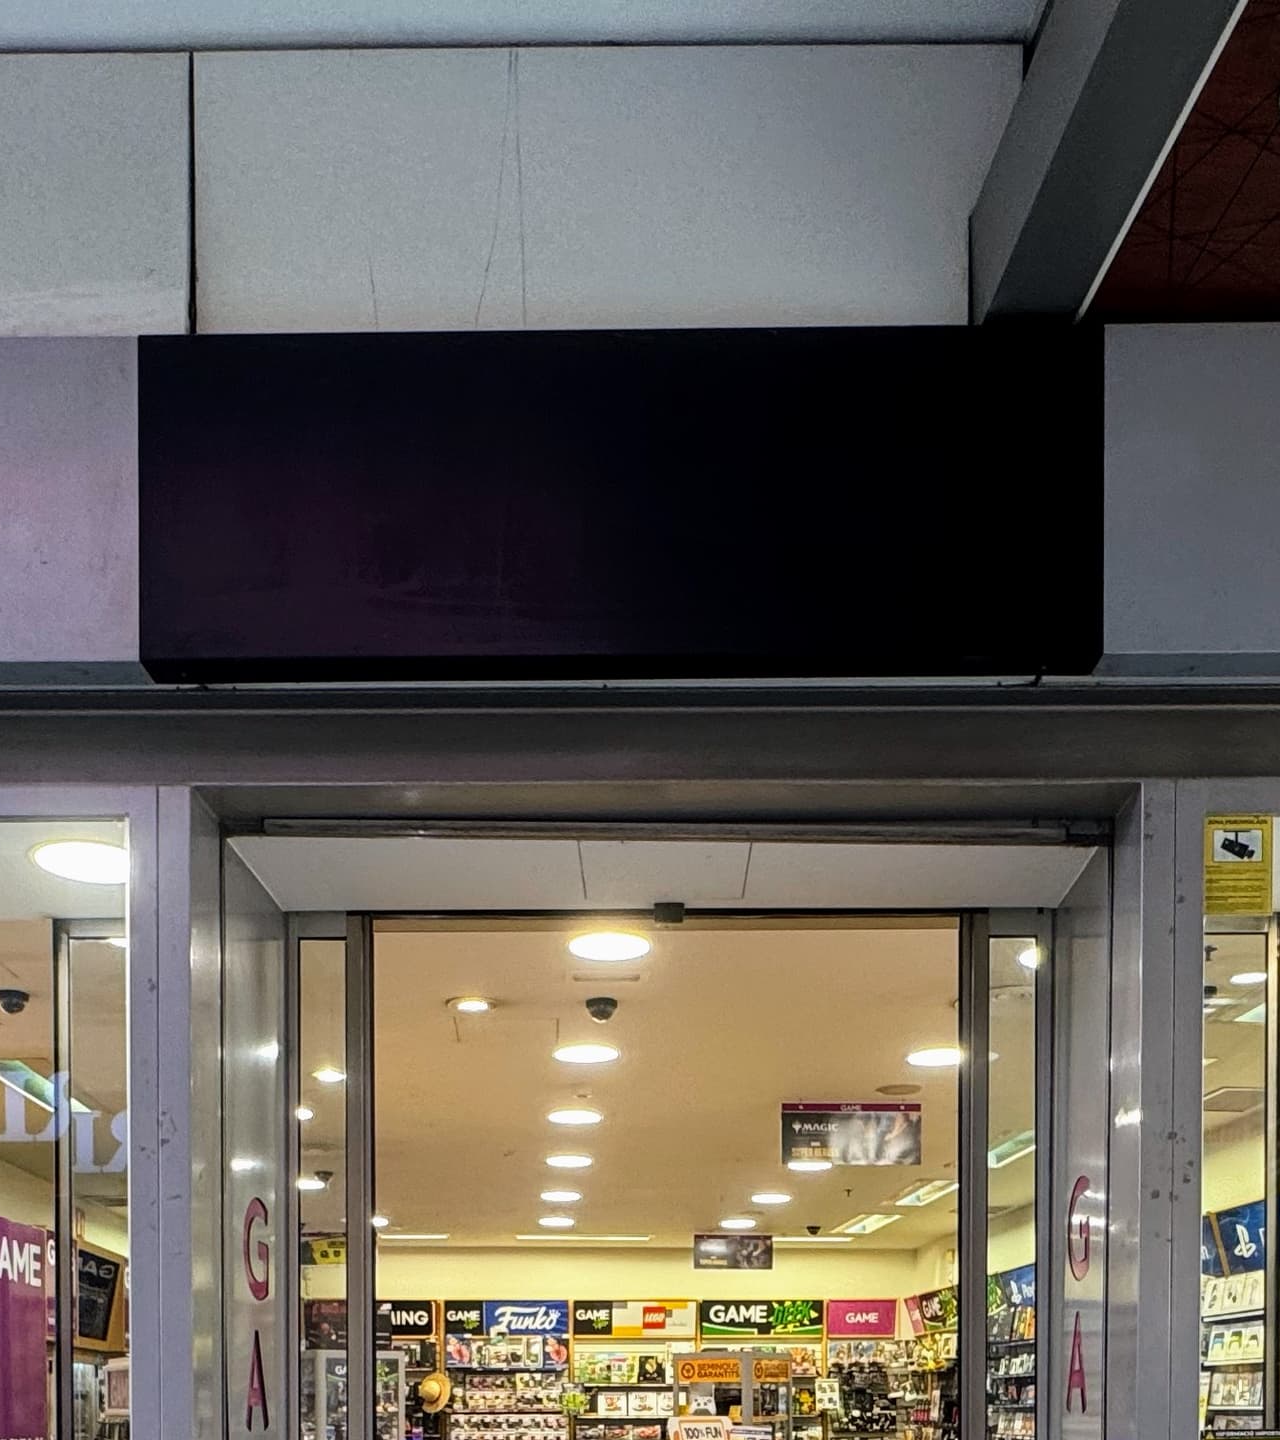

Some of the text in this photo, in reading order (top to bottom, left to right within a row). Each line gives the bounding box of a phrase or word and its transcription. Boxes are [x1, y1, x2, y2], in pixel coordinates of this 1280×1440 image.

[802, 1123, 839, 1131] MAGIC
[447, 1310, 480, 1321] GAME
[494, 1306, 561, 1332] Funko
[576, 1309, 610, 1320] GAME
[645, 1311, 665, 1323] LEGO
[709, 1304, 768, 1323] GAME
[846, 1312, 879, 1323] GAME
[705, 1426, 723, 1439] FUN
